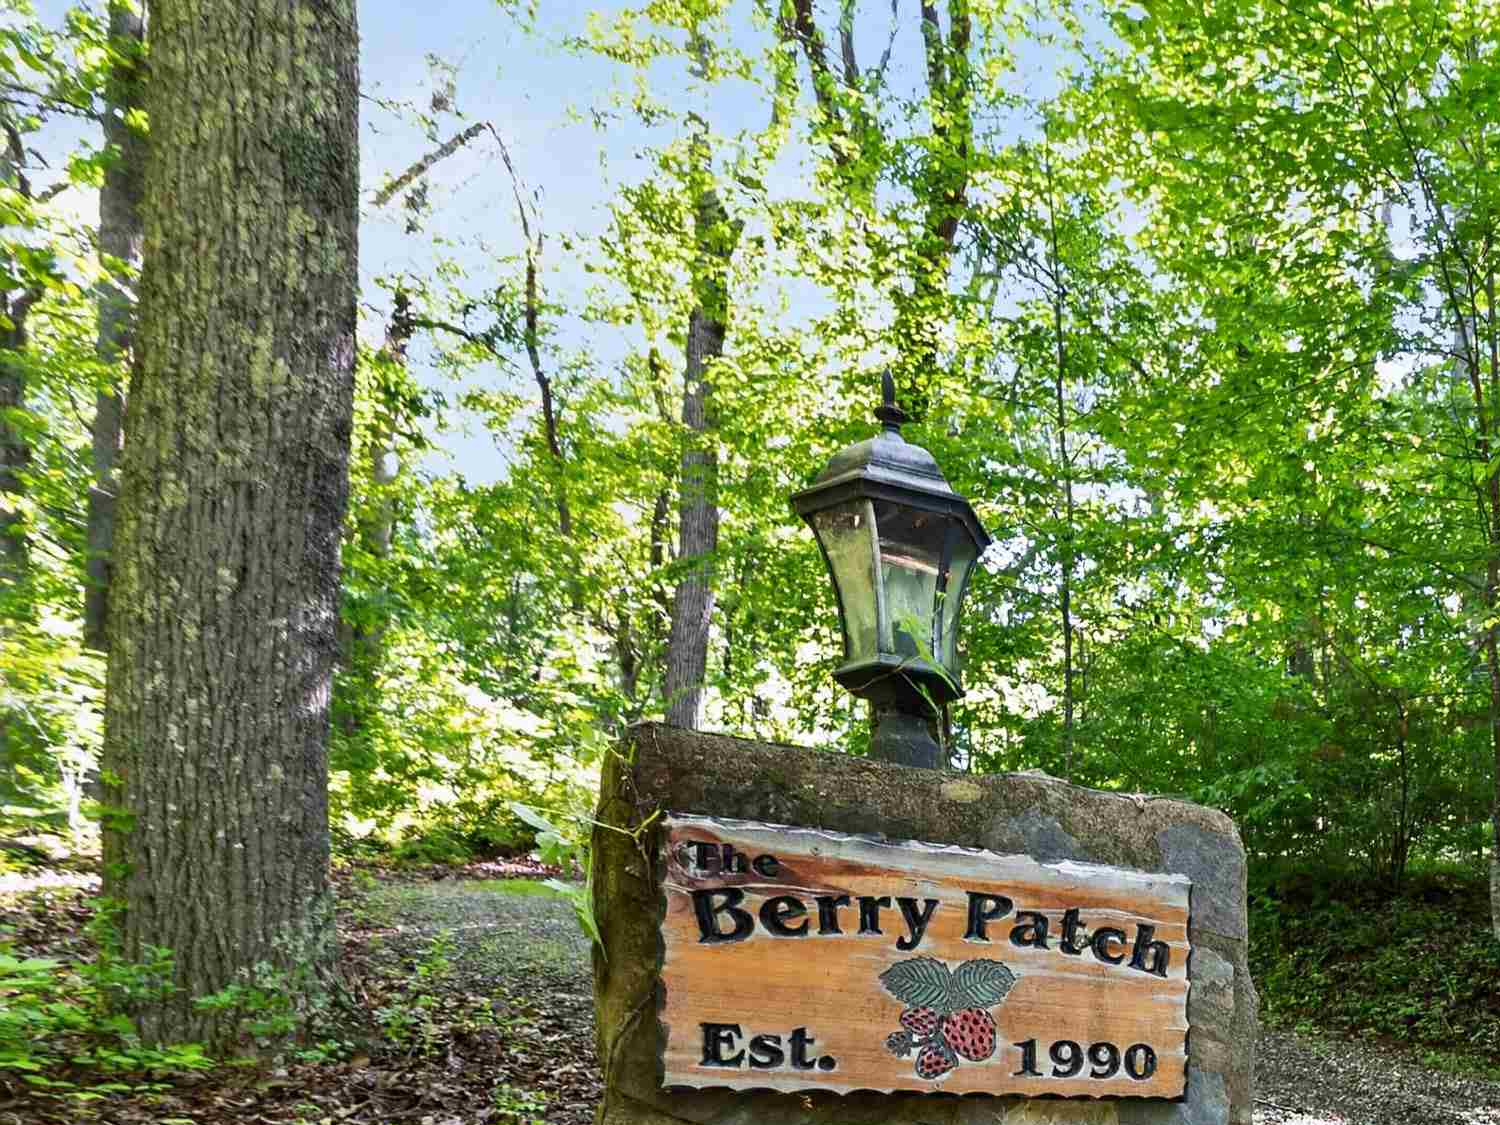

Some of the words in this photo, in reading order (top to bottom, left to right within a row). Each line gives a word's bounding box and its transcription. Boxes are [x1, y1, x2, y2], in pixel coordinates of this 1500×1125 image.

[692, 887, 939, 950] Berry
[964, 890, 1171, 978] Patch
[698, 1022, 836, 1072] Est.
[1013, 1039, 1157, 1080] 1990
